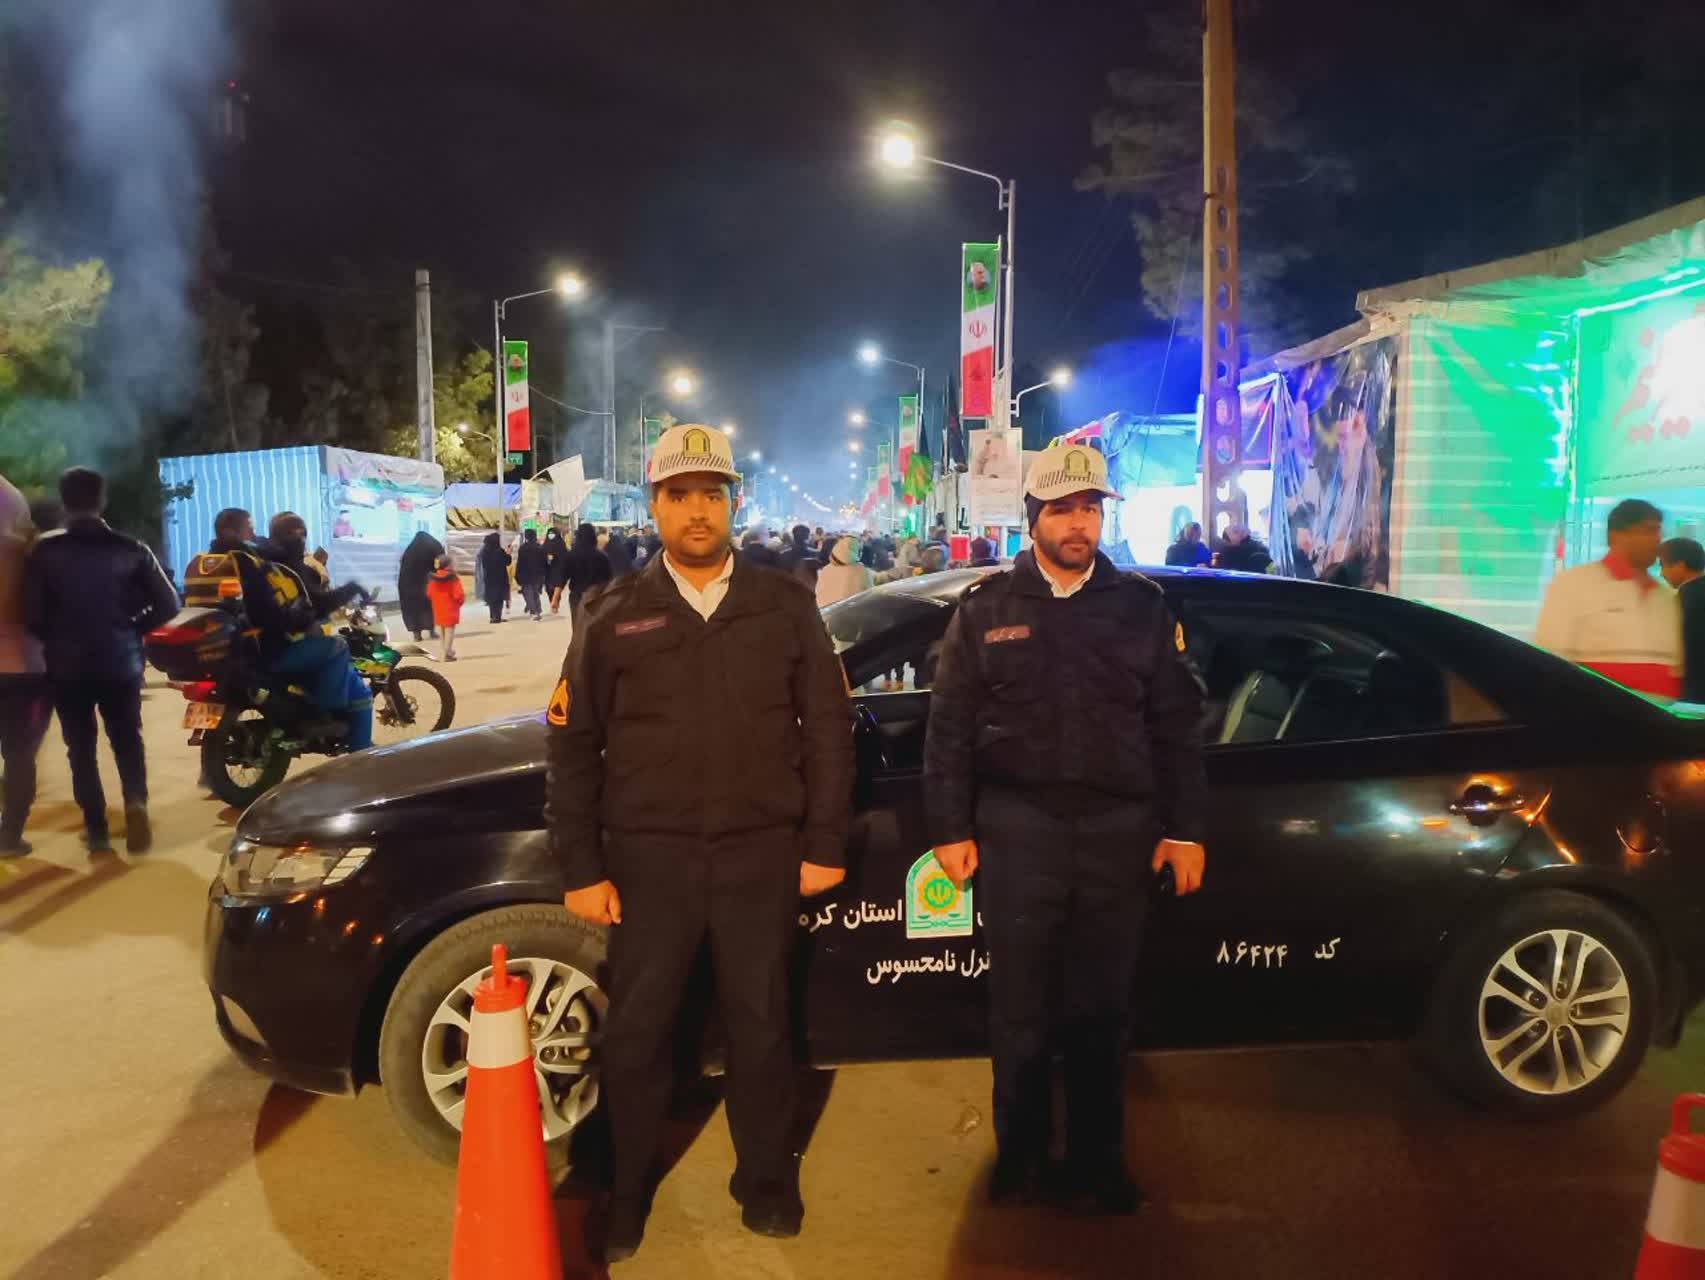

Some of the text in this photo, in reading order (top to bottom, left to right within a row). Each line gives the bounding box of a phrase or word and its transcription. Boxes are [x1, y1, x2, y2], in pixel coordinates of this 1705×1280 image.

[843, 898, 903, 930] استان
[1314, 937, 1341, 960] کد
[866, 949, 957, 985] نامحسوس
